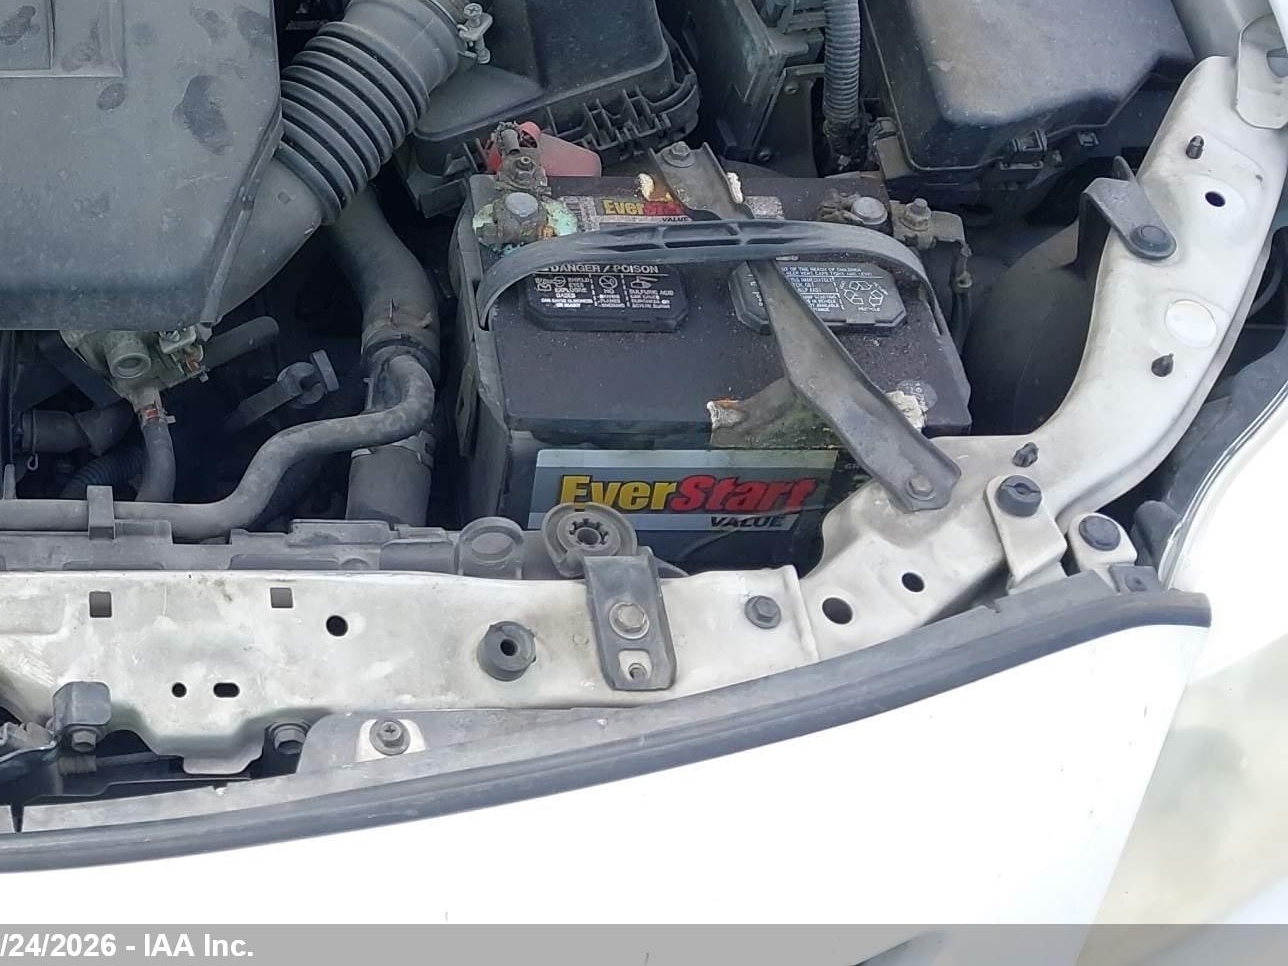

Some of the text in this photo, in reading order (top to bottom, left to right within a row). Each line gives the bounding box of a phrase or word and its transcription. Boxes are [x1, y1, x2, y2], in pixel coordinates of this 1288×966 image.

[550, 264, 601, 273] DANGER
[613, 265, 659, 274] POISON
[561, 474, 817, 512] EverStart
[710, 515, 787, 529] VALUE
